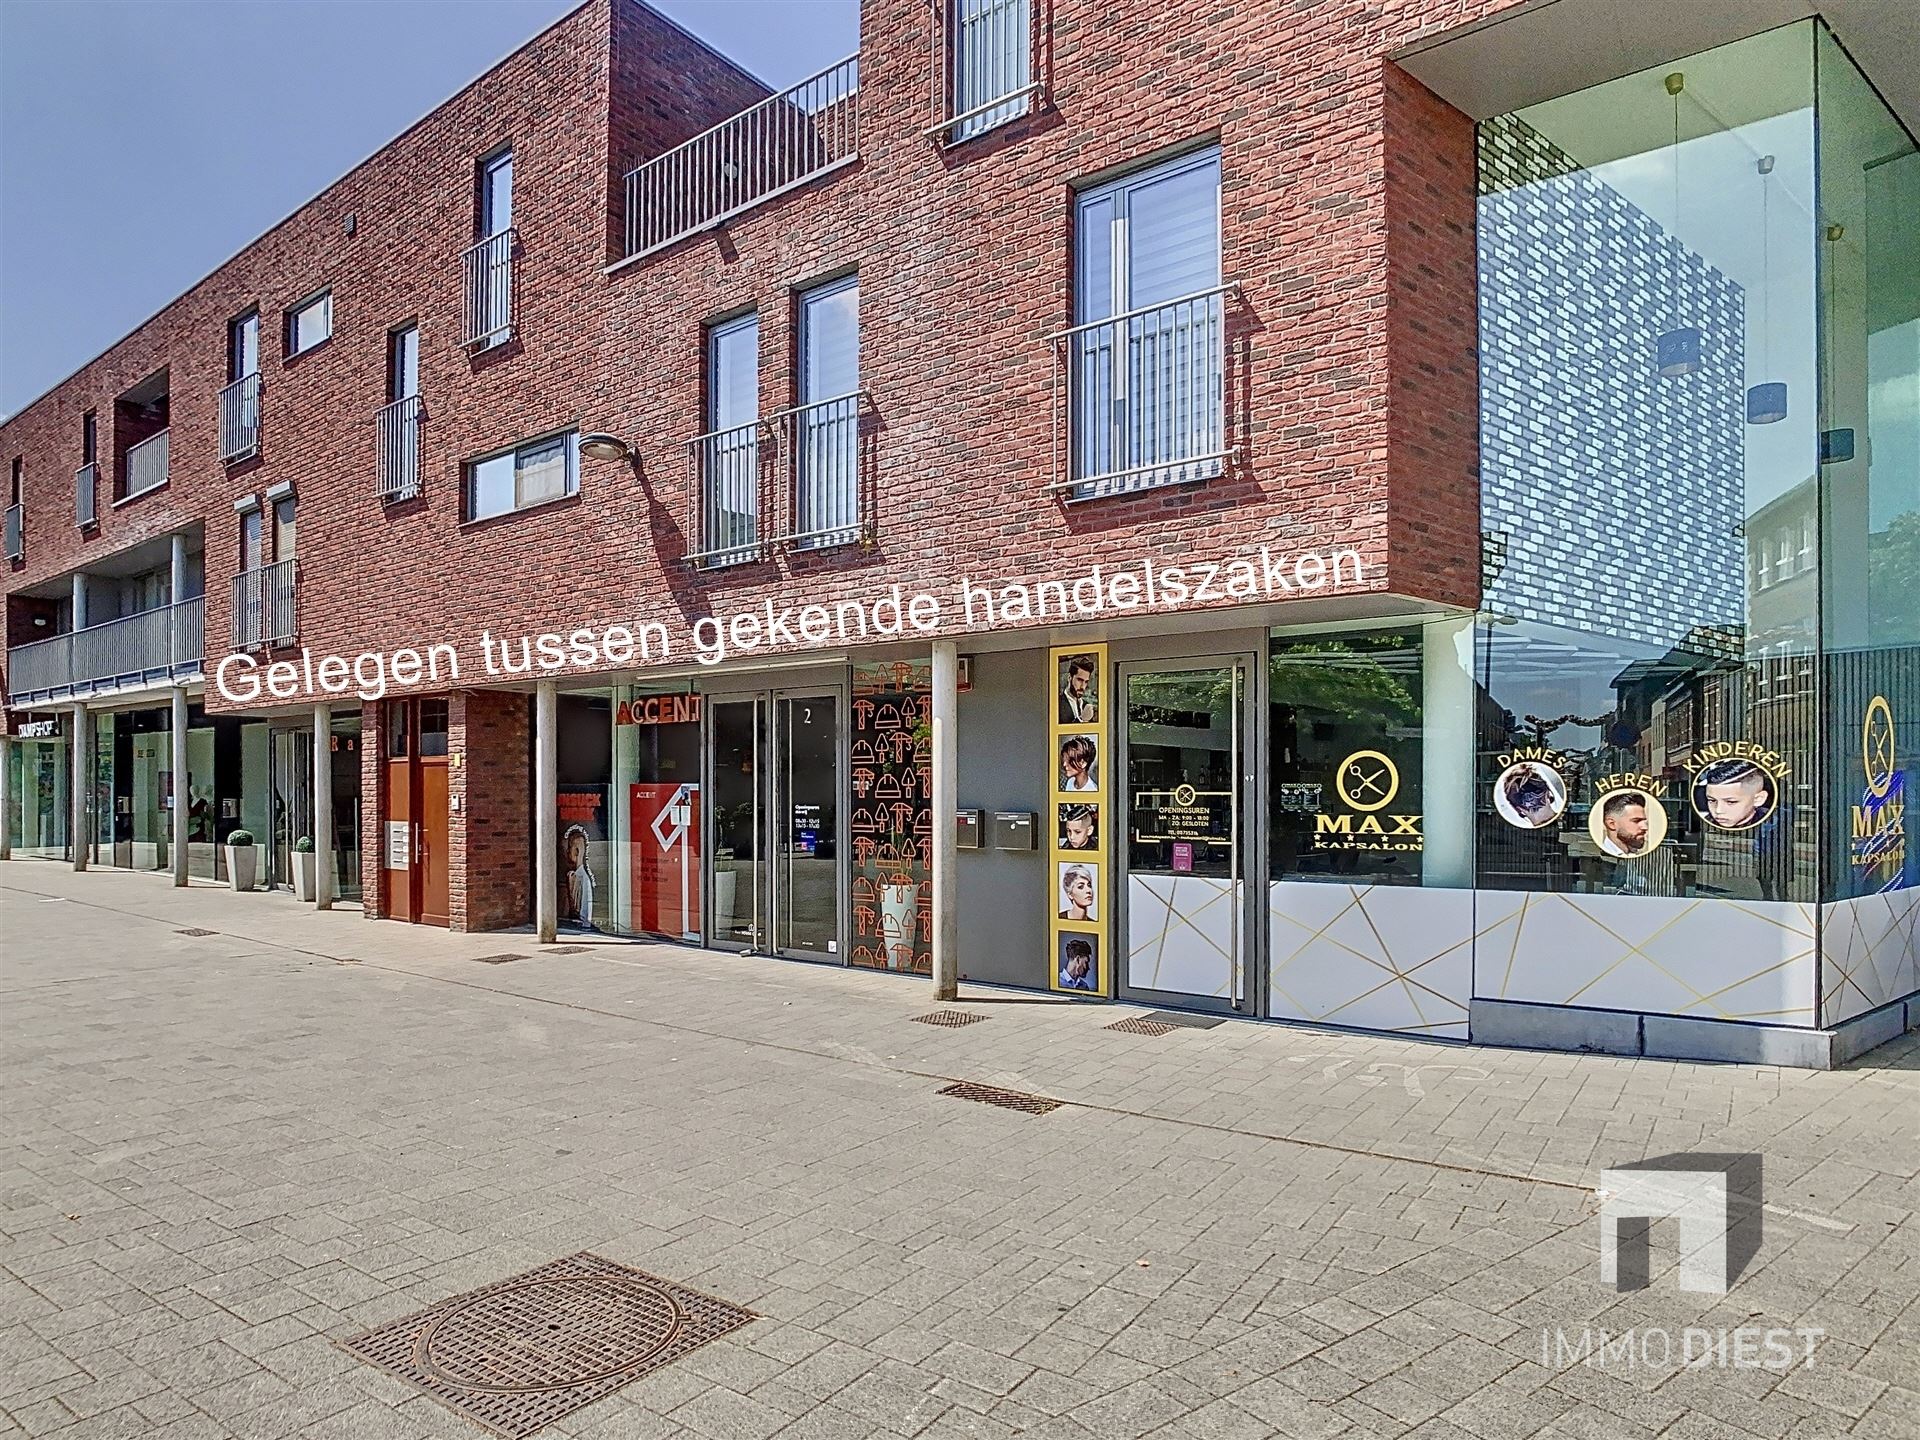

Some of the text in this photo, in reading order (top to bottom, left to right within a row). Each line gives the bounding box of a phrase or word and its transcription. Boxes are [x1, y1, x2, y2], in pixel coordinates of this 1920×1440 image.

[615, 695, 702, 725] ACCENT
[804, 708, 811, 724] 2
[1496, 745, 1568, 770] DAMES
[1682, 740, 1793, 780] KINDEREN
[1594, 771, 1668, 798] HEREN
[1313, 814, 1425, 836] MAX
[1850, 804, 1906, 838] MAX
[1313, 840, 1425, 851] KAPSALON
